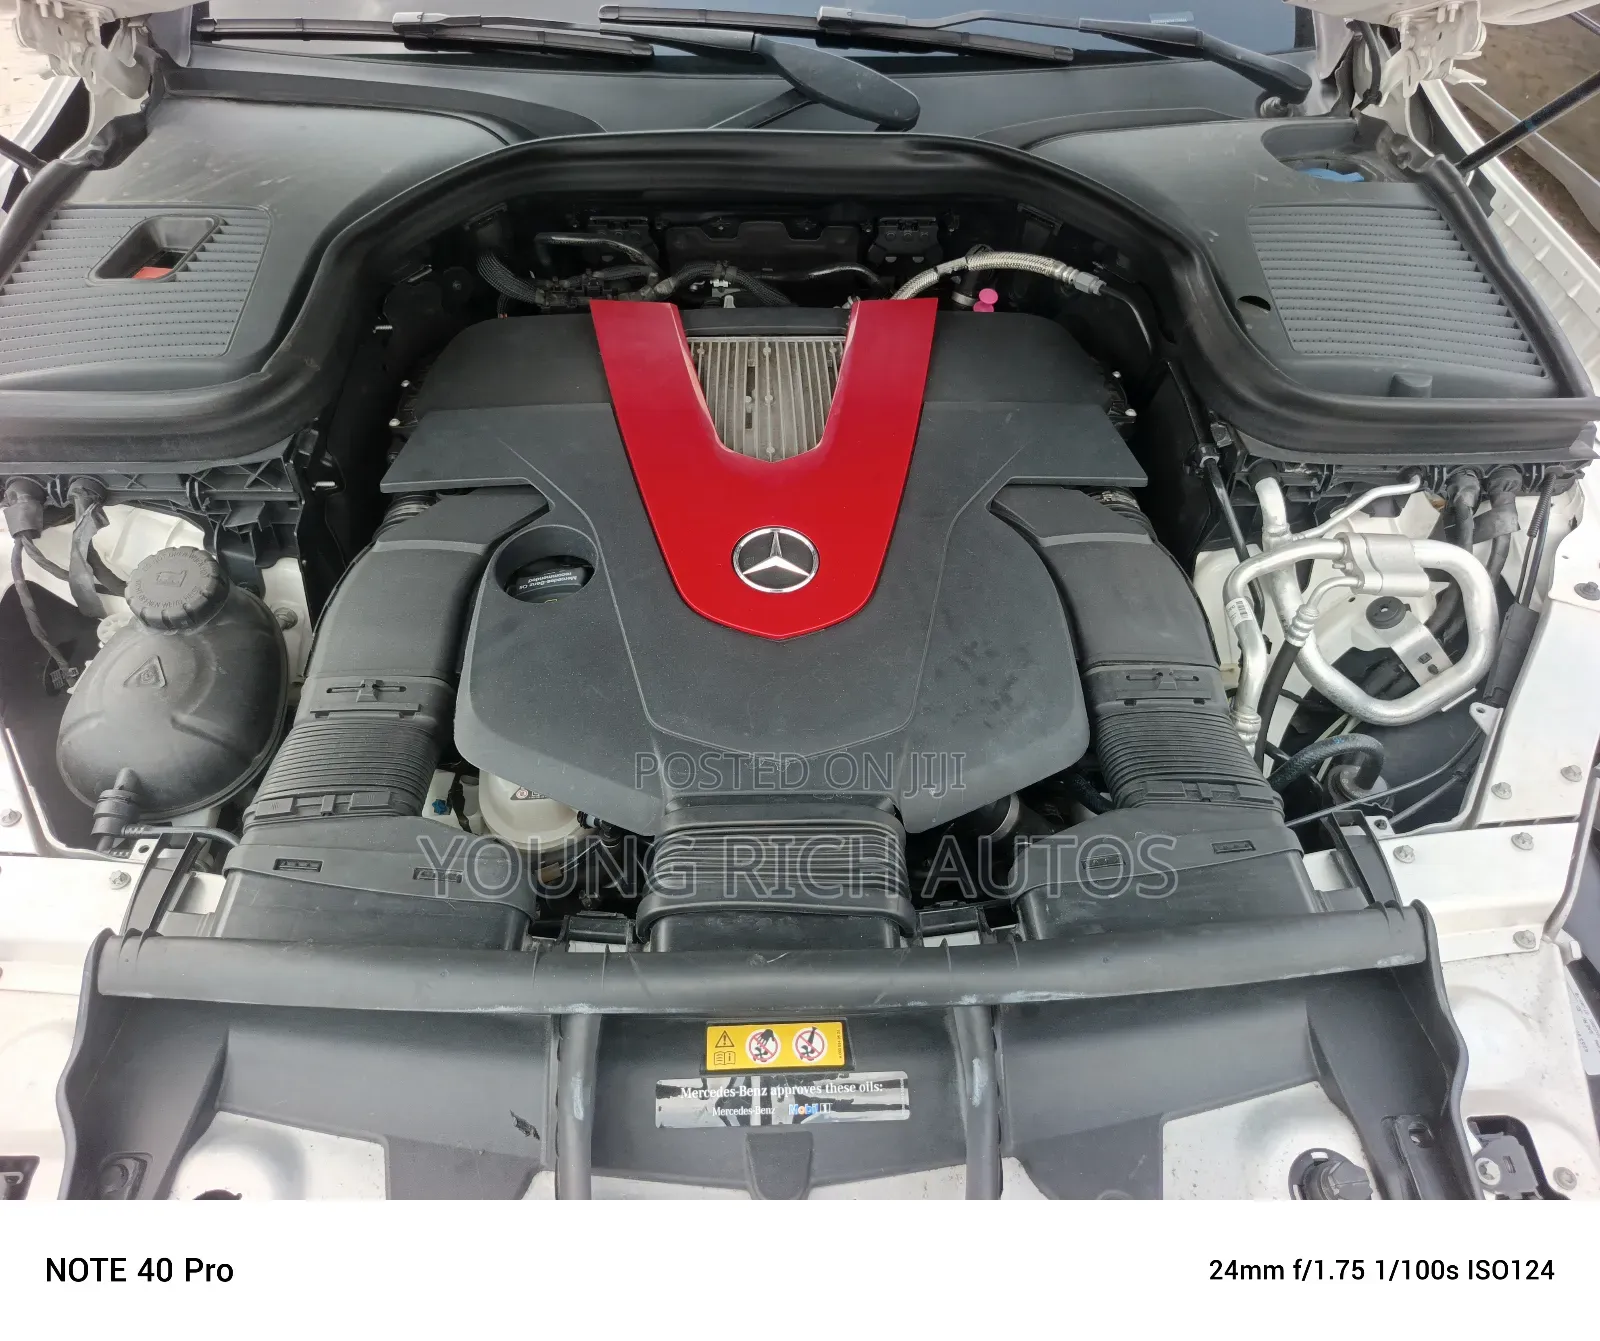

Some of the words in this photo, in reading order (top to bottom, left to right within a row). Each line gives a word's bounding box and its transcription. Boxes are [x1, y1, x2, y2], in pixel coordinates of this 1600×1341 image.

[680, 1085, 768, 1099] Mercedes-Benz
[770, 1084, 822, 1098] approves
[825, 1082, 856, 1094] these
[859, 1081, 883, 1092] oils:
[712, 1106, 776, 1117] Mercedes-Benz
[788, 1103, 819, 1116] Mobil
